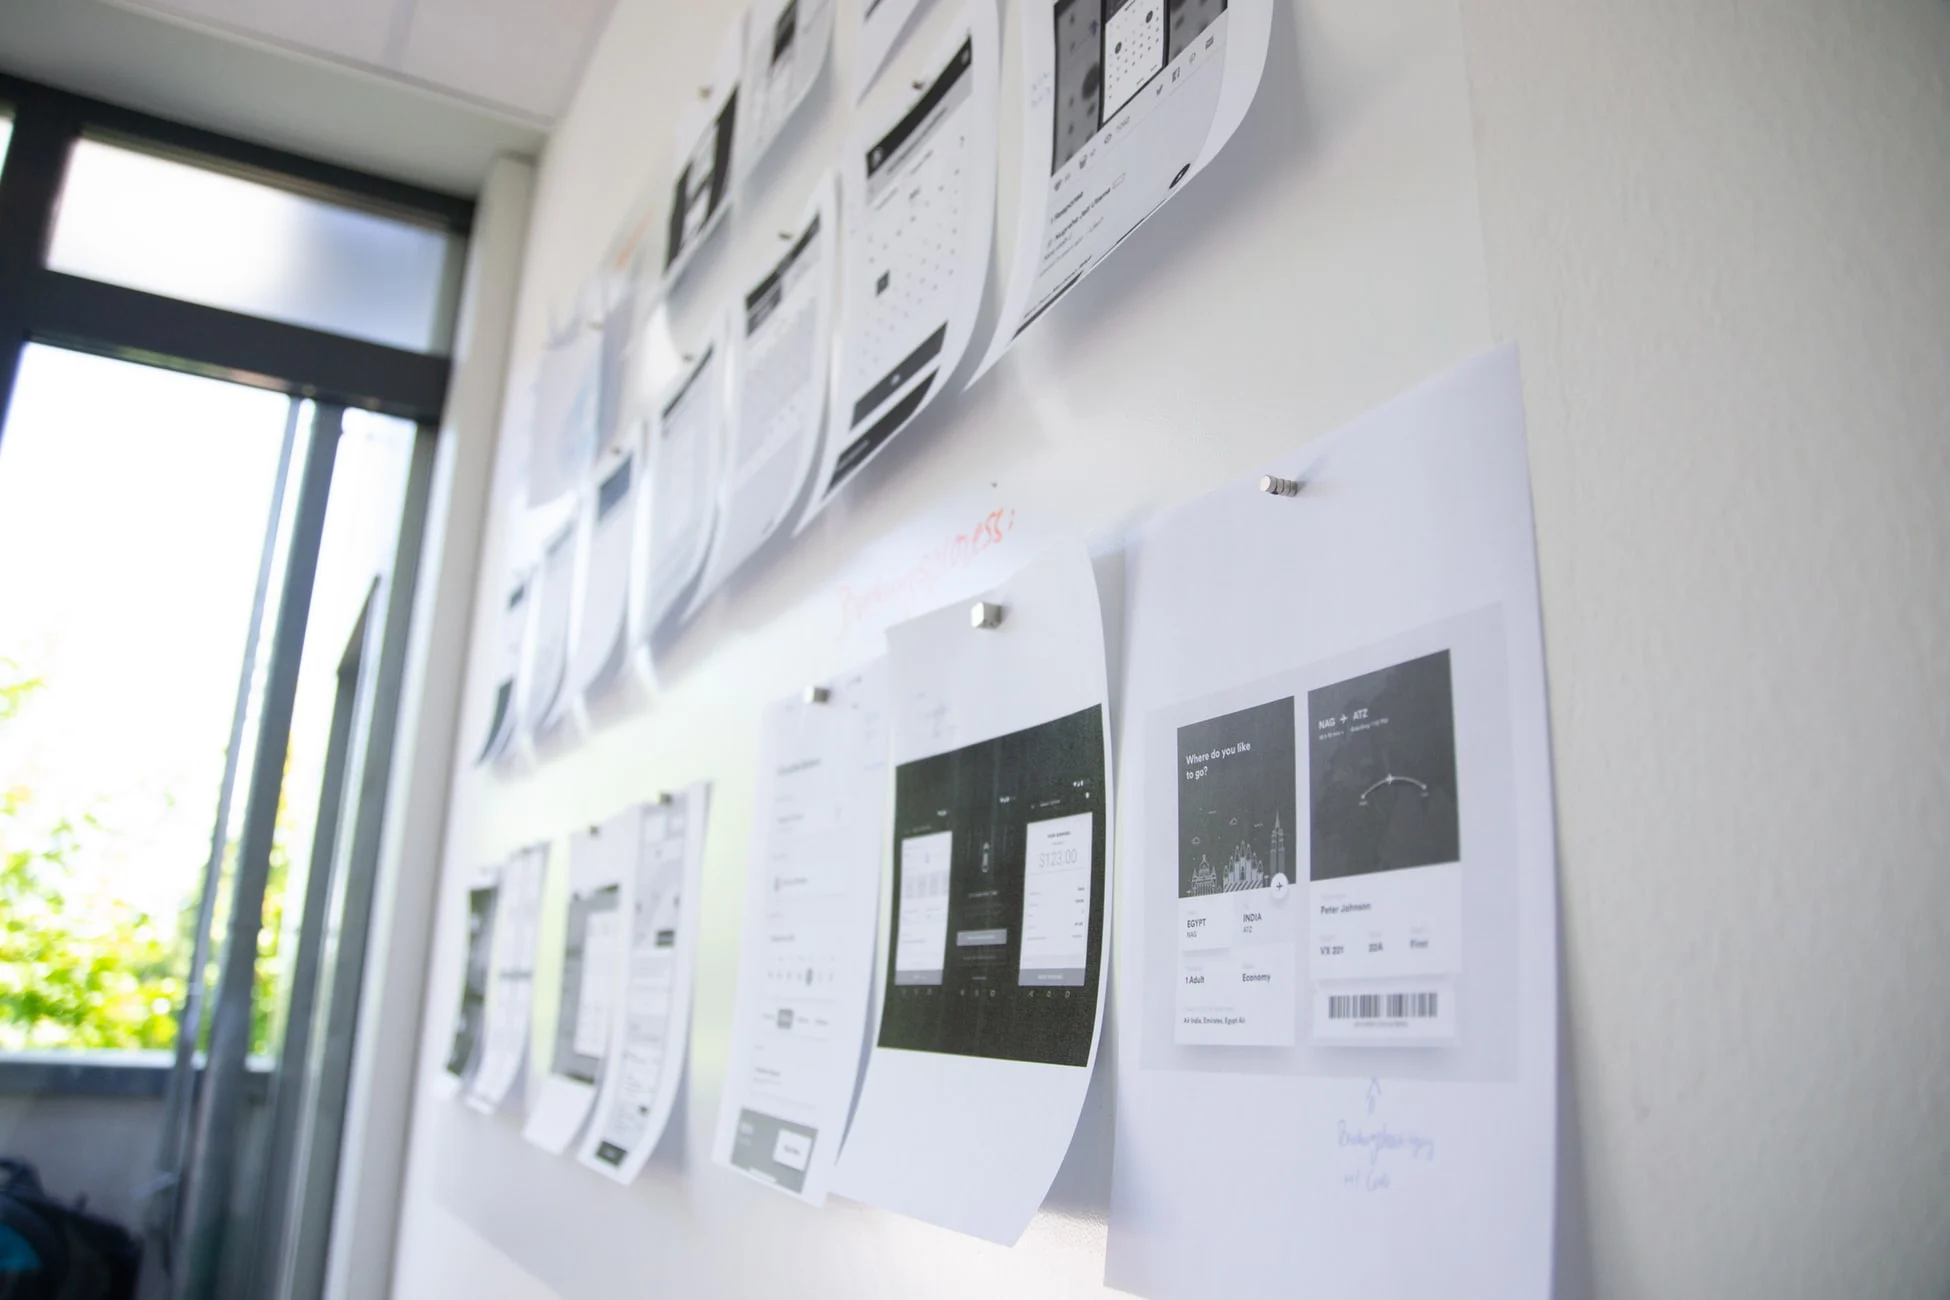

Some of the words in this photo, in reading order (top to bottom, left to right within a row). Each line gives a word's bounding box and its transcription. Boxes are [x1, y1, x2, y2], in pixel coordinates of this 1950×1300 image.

[1318, 717, 1336, 730] NAG
[1353, 708, 1369, 721] ATZ
[1185, 753, 1210, 765] Where
[1210, 748, 1221, 760] do
[1221, 746, 1236, 759] you
[1237, 741, 1251, 753] like
[1186, 770, 1194, 780] to
[1195, 766, 1208, 780] go?
[1039, 848, 1078, 868] $123.00
[1320, 905, 1339, 915] Peter
[1341, 902, 1372, 913] Johnson
[1186, 918, 1207, 928] EGYPT
[1243, 912, 1263, 922] INDIA
[1189, 975, 1205, 984] Adult
[1242, 973, 1271, 983] Economy
